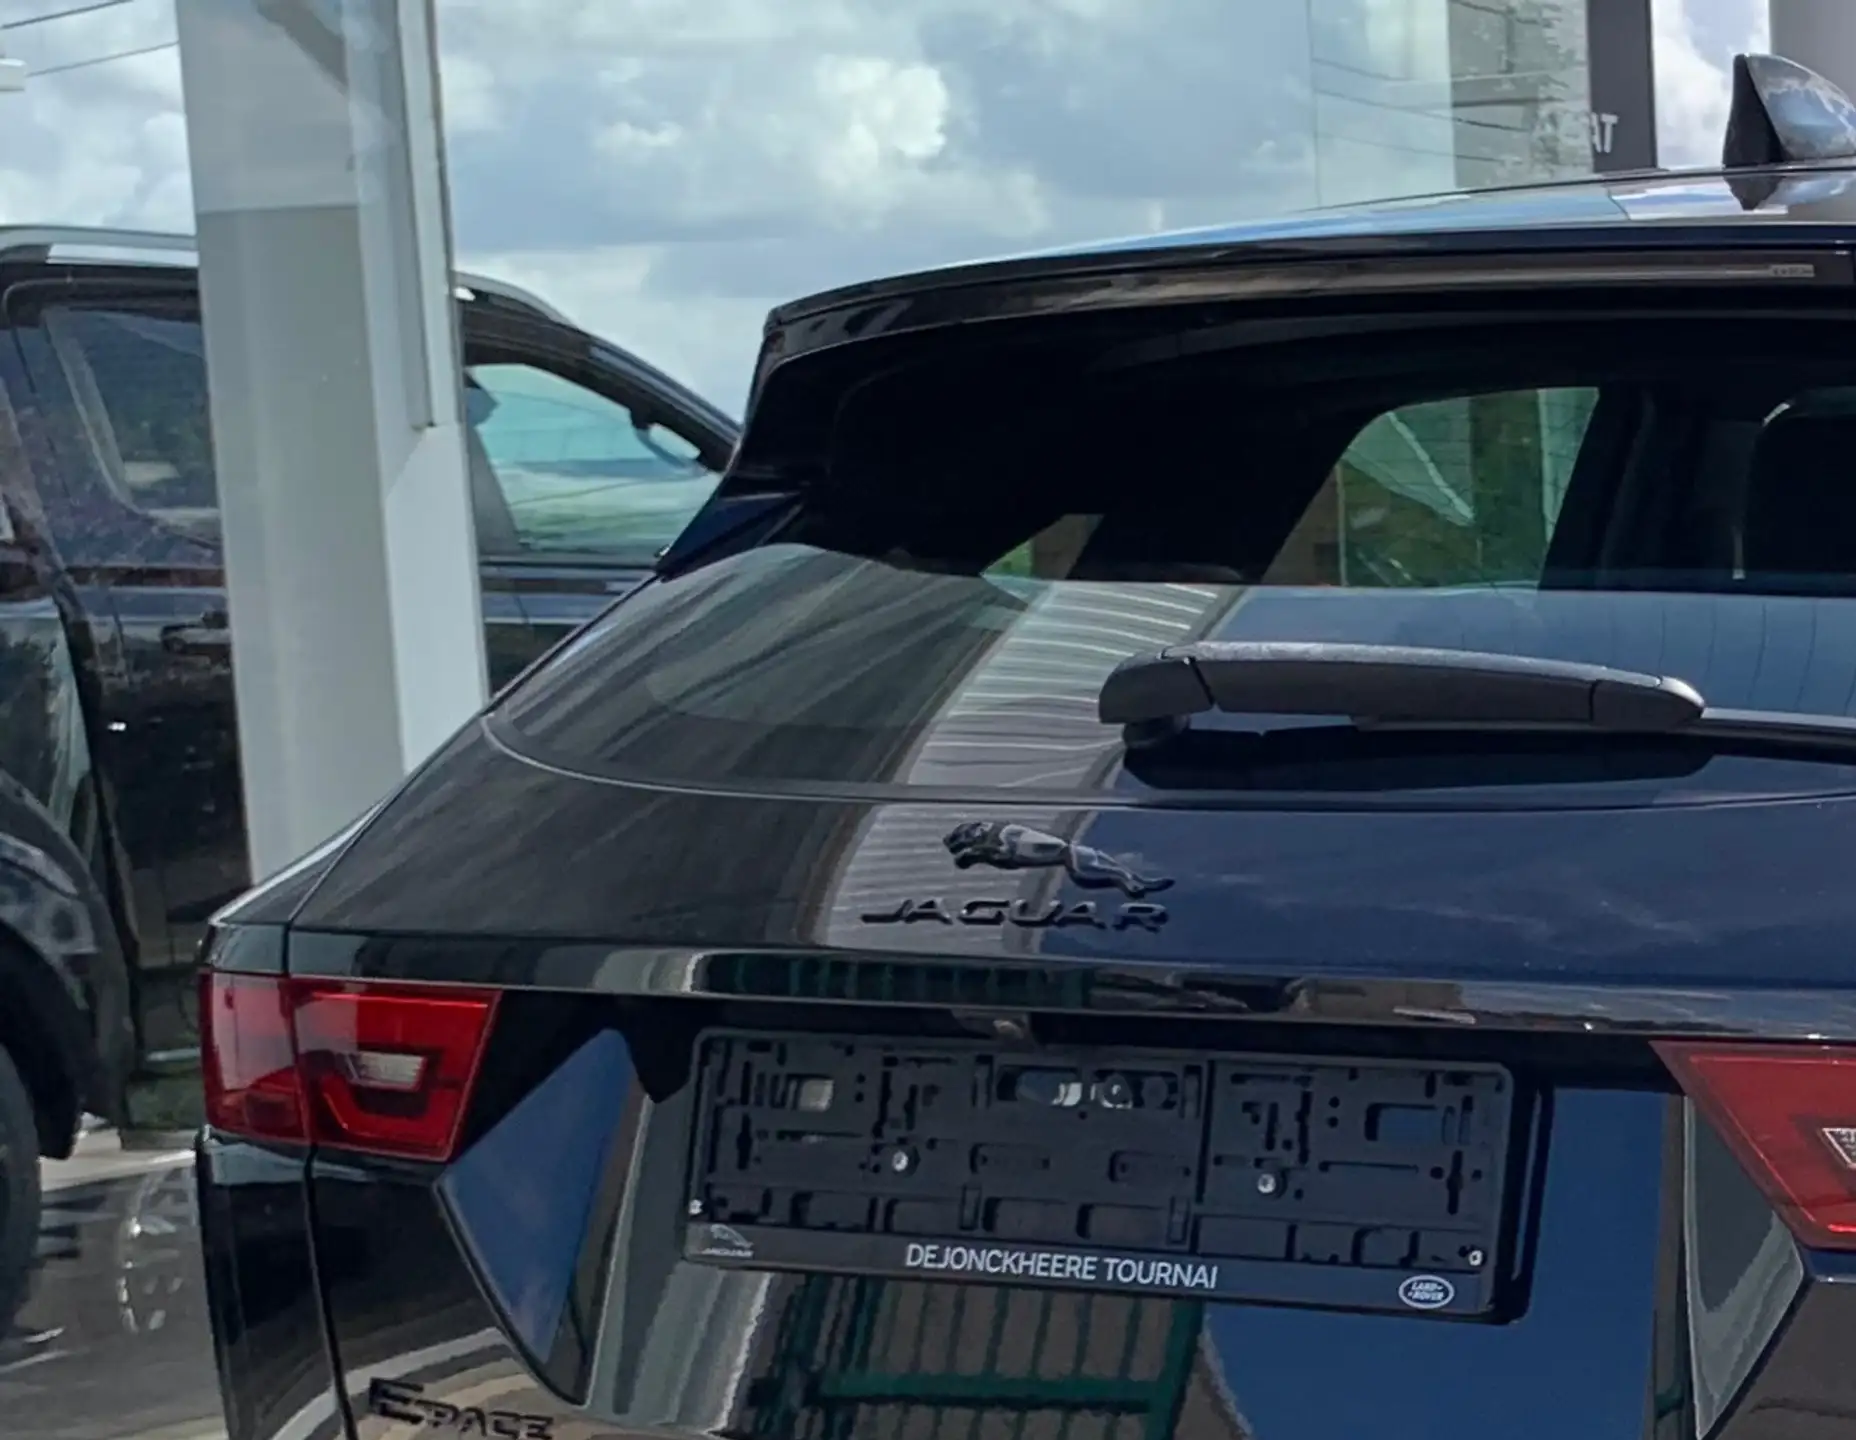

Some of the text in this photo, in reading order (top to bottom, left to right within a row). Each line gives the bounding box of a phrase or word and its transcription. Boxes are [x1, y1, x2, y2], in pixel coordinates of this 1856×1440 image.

[860, 899, 1170, 932] JAGUAR
[905, 1243, 1218, 1289] DEJONCKHEERE TOURNAI
